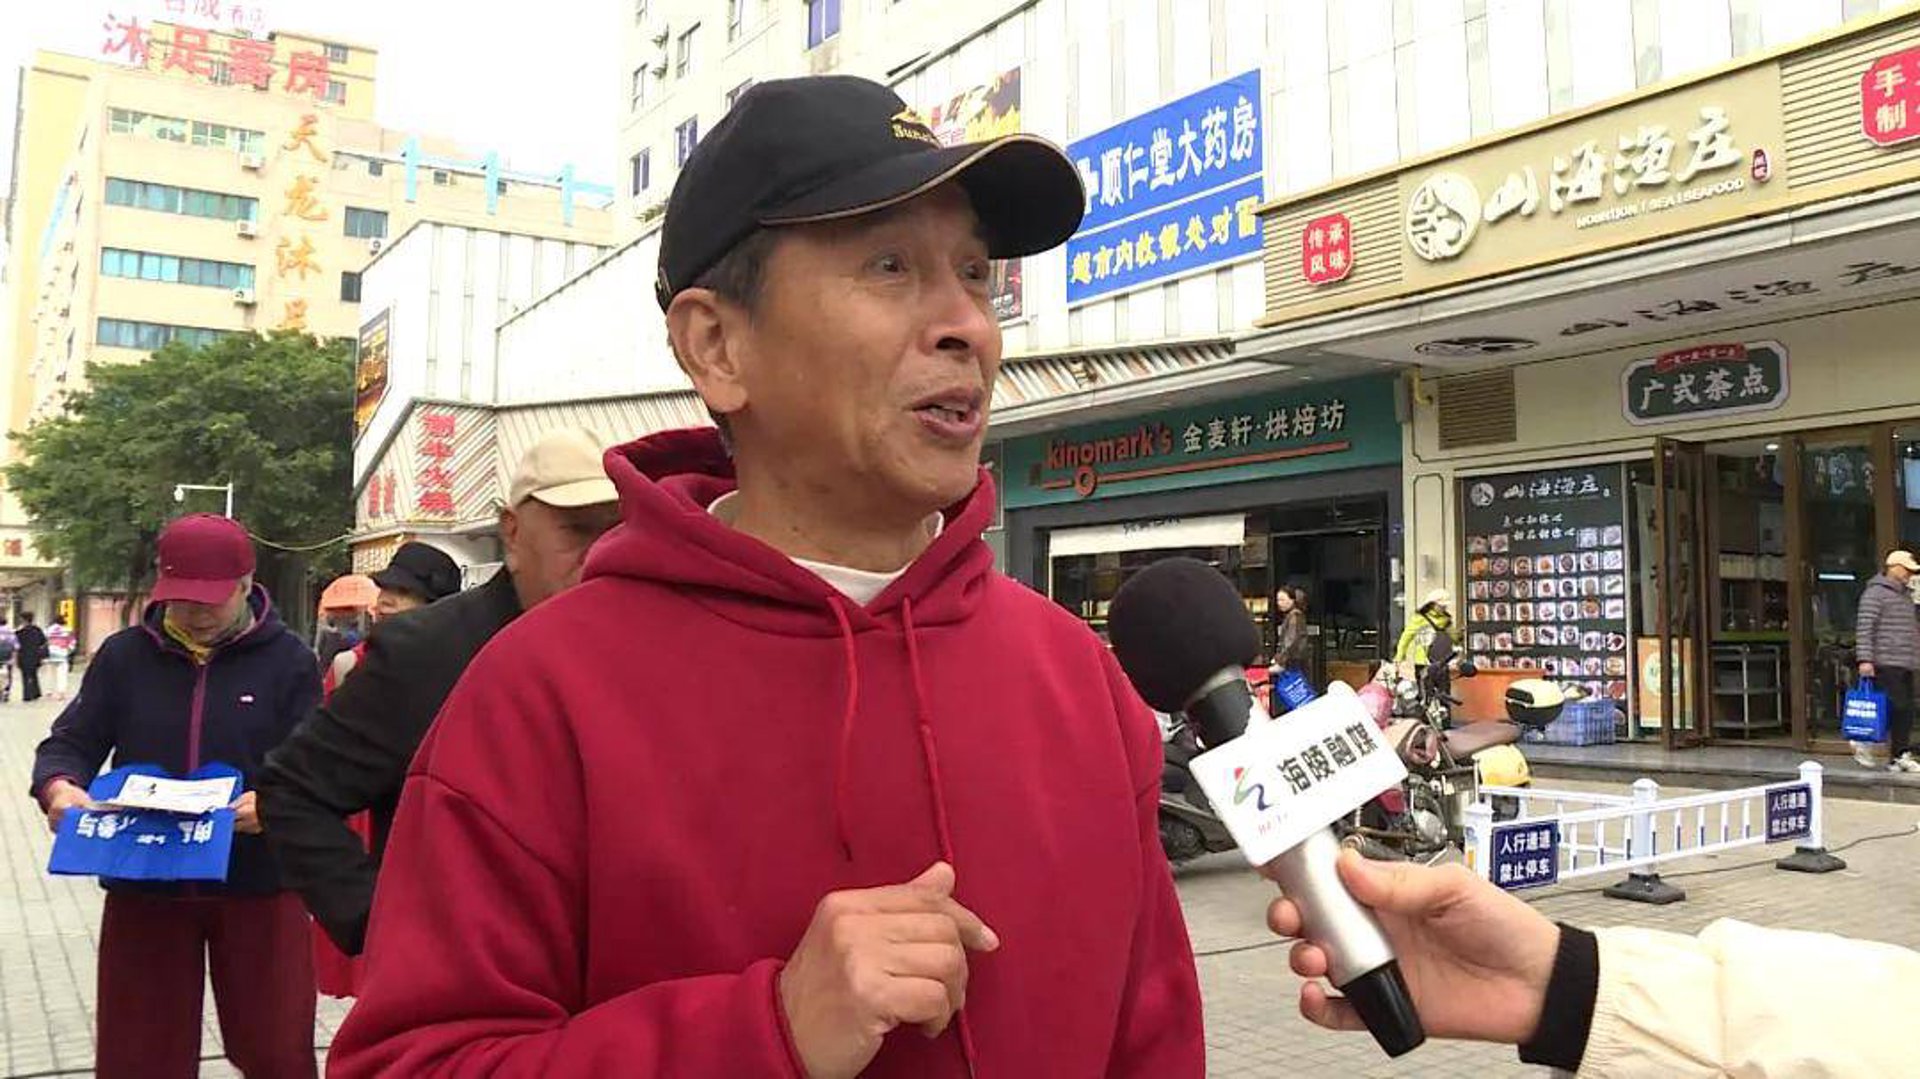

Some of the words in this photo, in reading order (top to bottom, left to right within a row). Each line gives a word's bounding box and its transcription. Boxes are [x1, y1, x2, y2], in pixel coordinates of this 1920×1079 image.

[1483, 106, 1742, 222] 山海渔庄
[1649, 195, 1676, 211] SEA
[1684, 177, 1745, 203] SEAFOOD
[1308, 223, 1345, 250] 传承
[1311, 249, 1347, 274] 风味
[1640, 364, 1771, 411] 广式茶点
[1277, 721, 1378, 795] 海陵融媒
[1772, 791, 1807, 812] 人行通道
[1772, 814, 1807, 836] 禁止停车
[1500, 829, 1551, 855] 人行通道
[1500, 858, 1550, 883] 禁止停车
